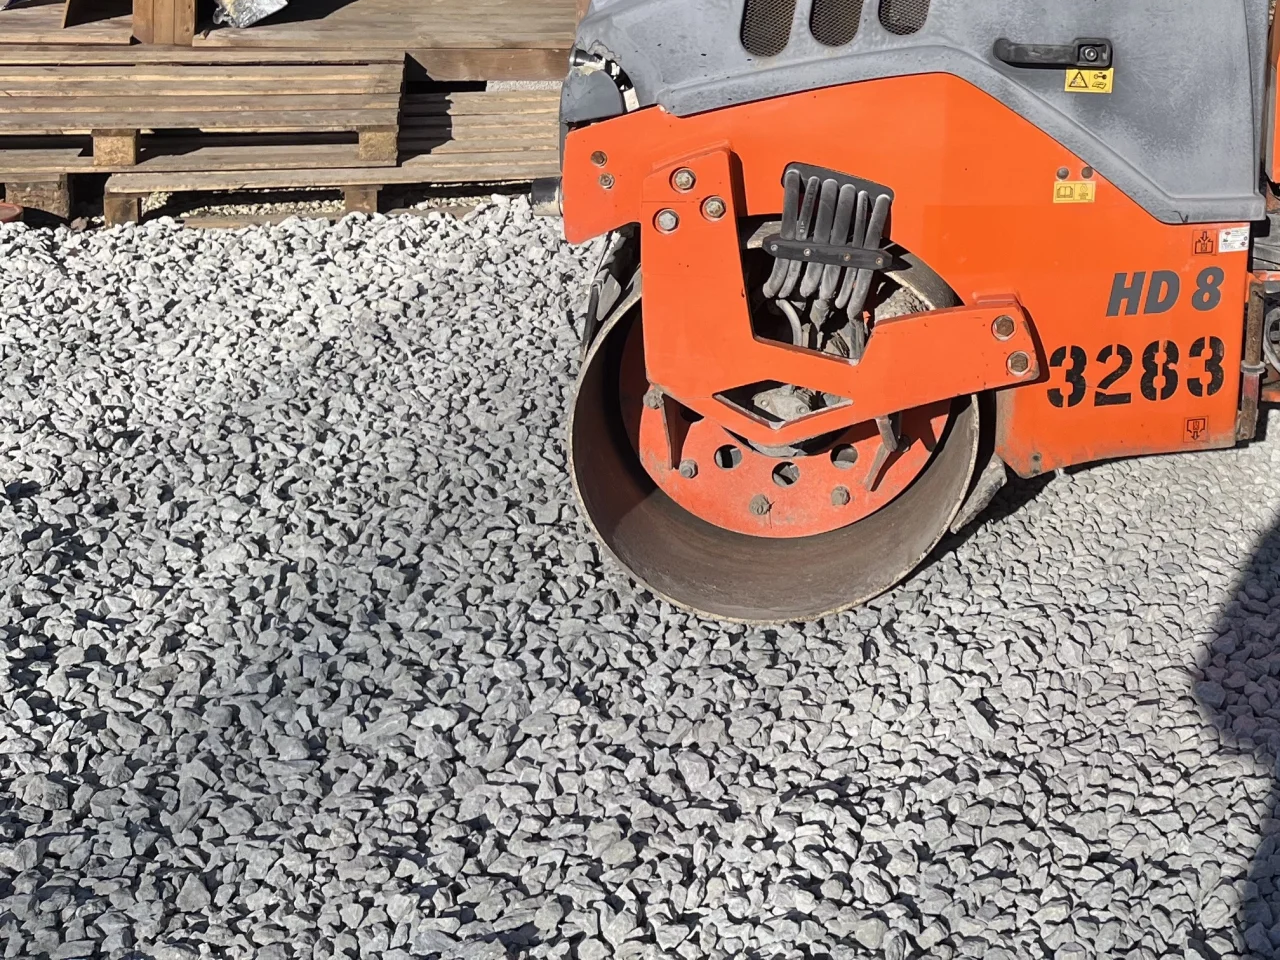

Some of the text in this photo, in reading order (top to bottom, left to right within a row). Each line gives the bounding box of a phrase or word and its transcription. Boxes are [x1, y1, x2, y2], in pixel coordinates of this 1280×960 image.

[1105, 266, 1225, 317] HD 8
[1046, 335, 1225, 409] 3283
